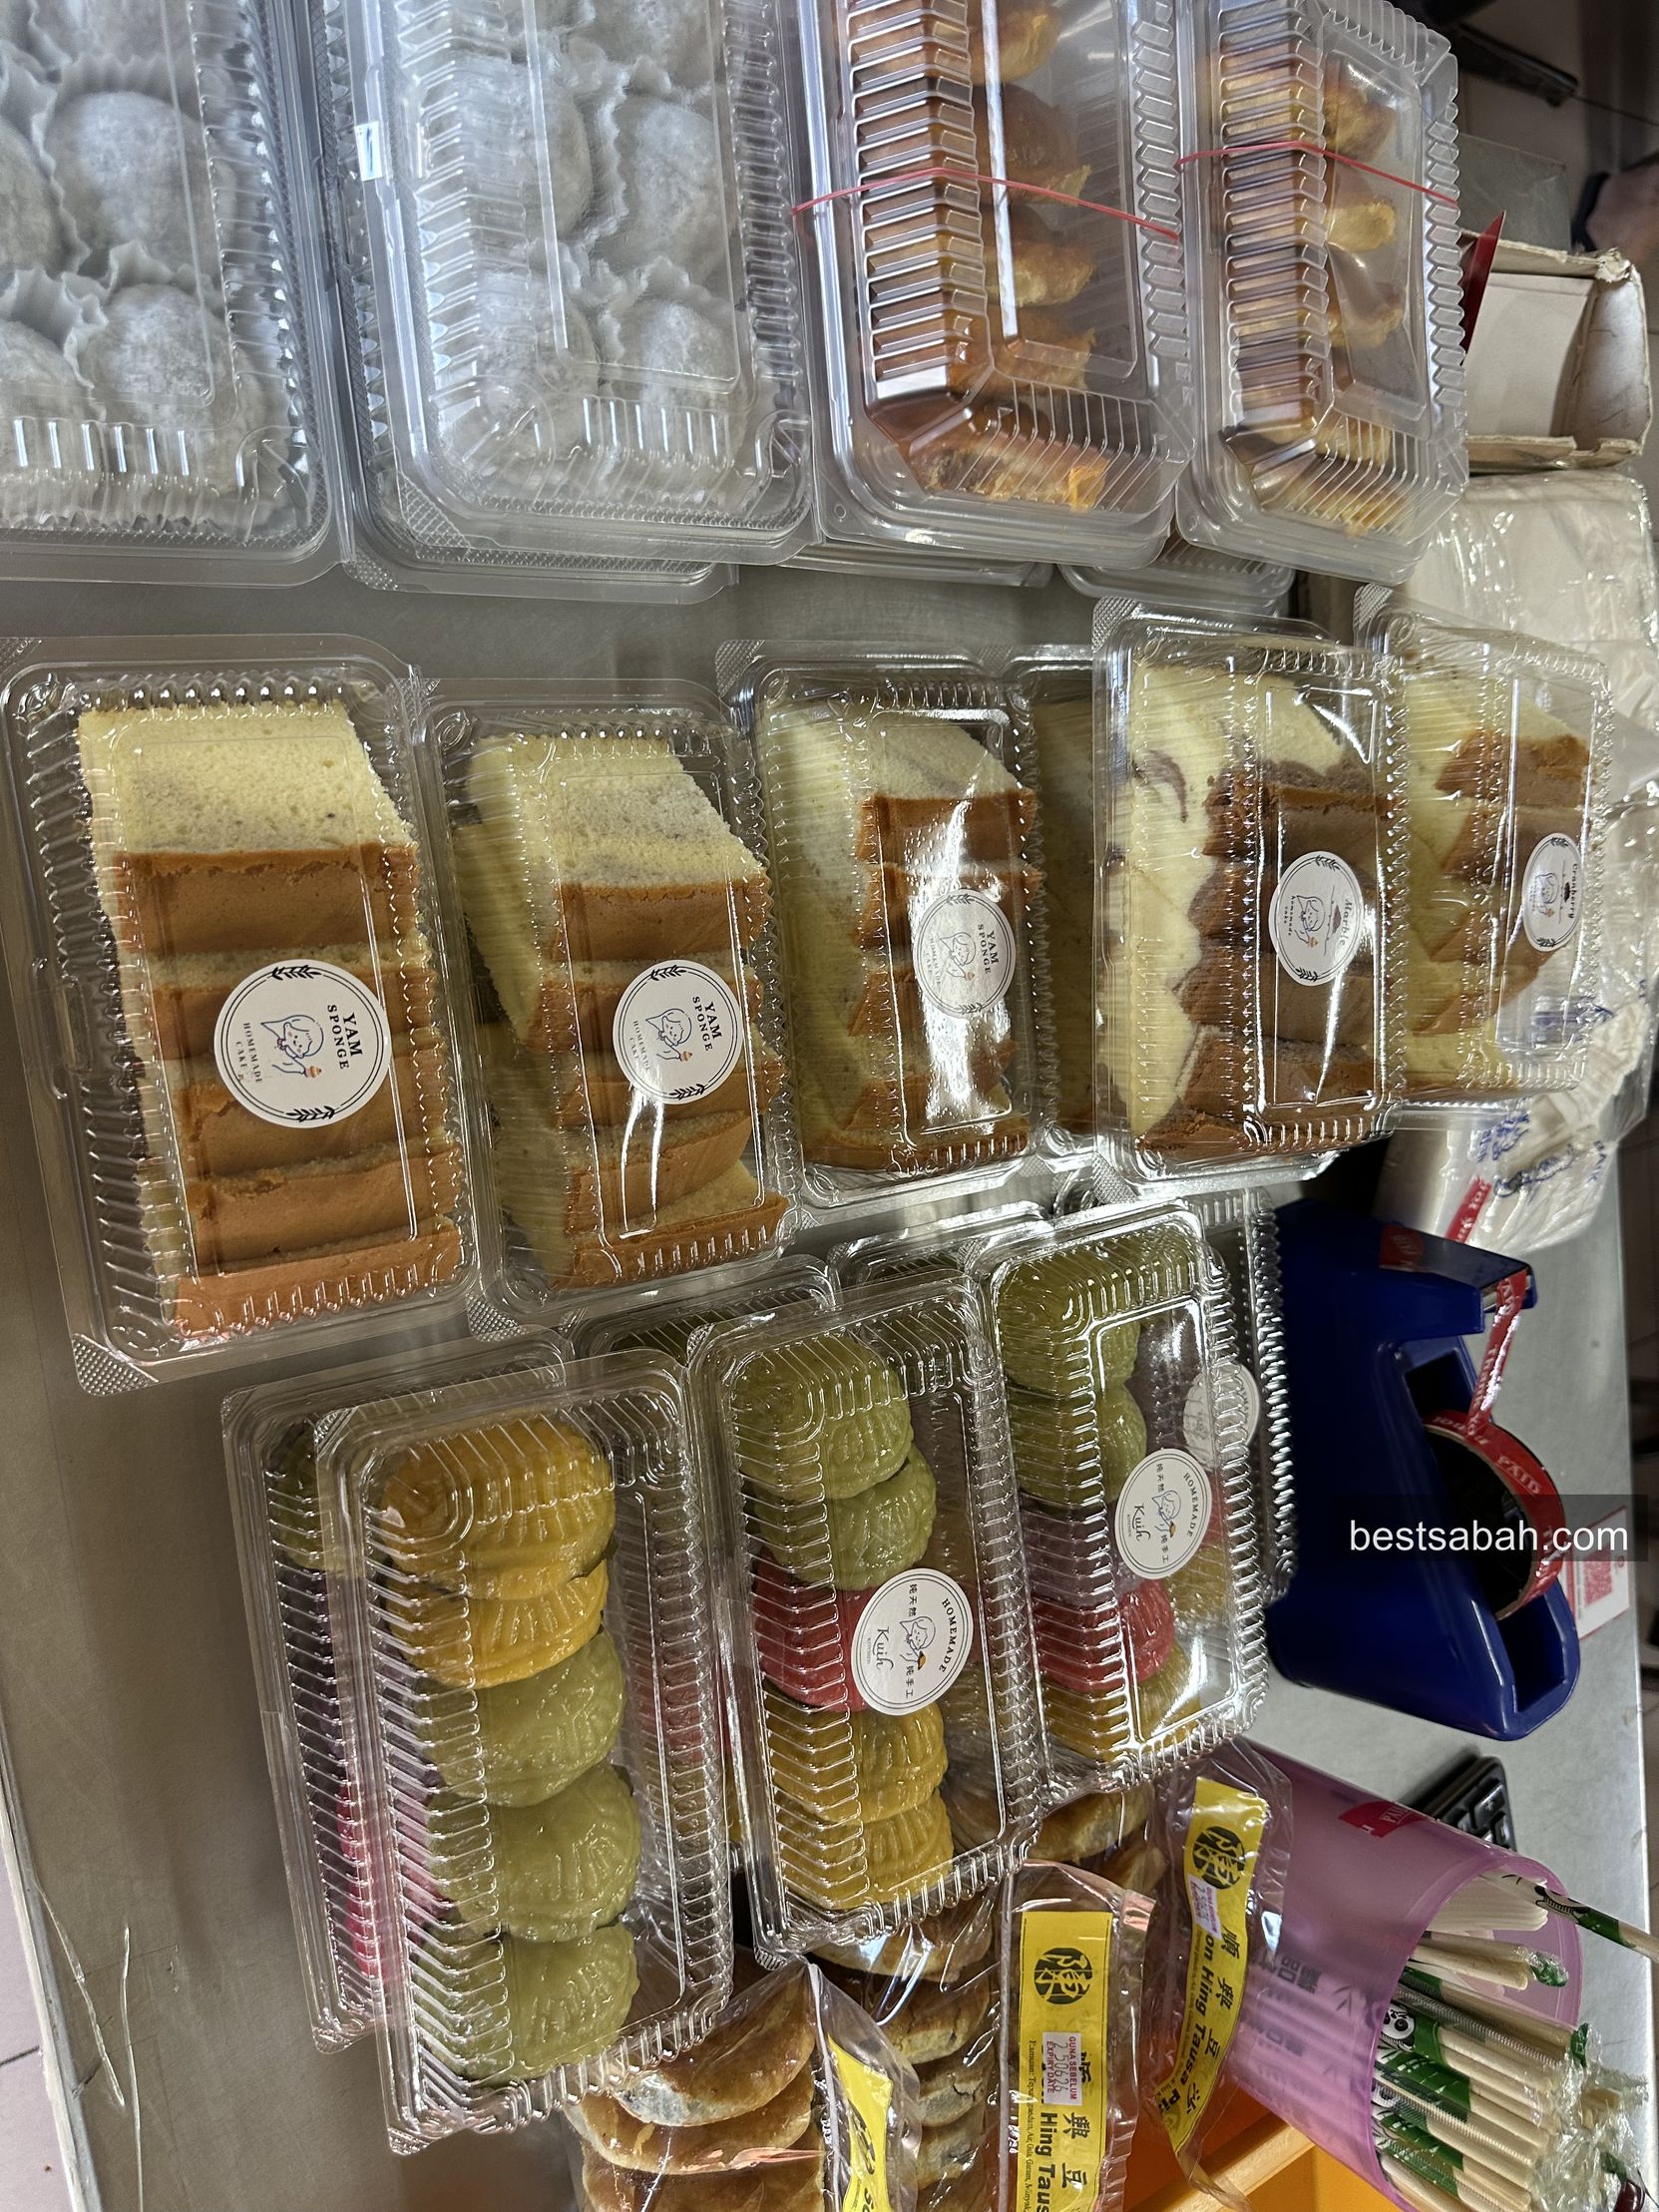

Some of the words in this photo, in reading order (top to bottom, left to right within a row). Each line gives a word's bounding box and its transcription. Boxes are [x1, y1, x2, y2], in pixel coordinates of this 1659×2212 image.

[1568, 863, 1578, 919] Cranberry
[987, 930, 999, 964] YAM
[1339, 899, 1353, 947] Marble
[978, 924, 992, 974] SPONGE
[327, 1005, 349, 1070] SPONGE
[343, 1013, 363, 1057] YAM
[692, 996, 713, 1052] SPONGE
[704, 1002, 722, 1040] YAM
[234, 1041, 248, 1069] CAKE
[242, 1023, 263, 1085] HOMEMADE
[632, 1020, 650, 1072] HOMEMADE
[1473, 1344, 1498, 1409] Thank
[1495, 1454, 1541, 1495] PAID
[1132, 1503, 1151, 1541] Kuih
[1182, 1472, 1198, 1538] HOMEMADE
[872, 1626, 894, 1670] Kuih
[938, 1597, 957, 1673] HOMEMADE
[1195, 1966, 1214, 2017] Hing
[1180, 2022, 1206, 2086] Tausa
[1035, 2112, 1057, 2156] Hing
[1025, 2159, 1034, 2182] Garam,
[1037, 2164, 1055, 2212] Taus
